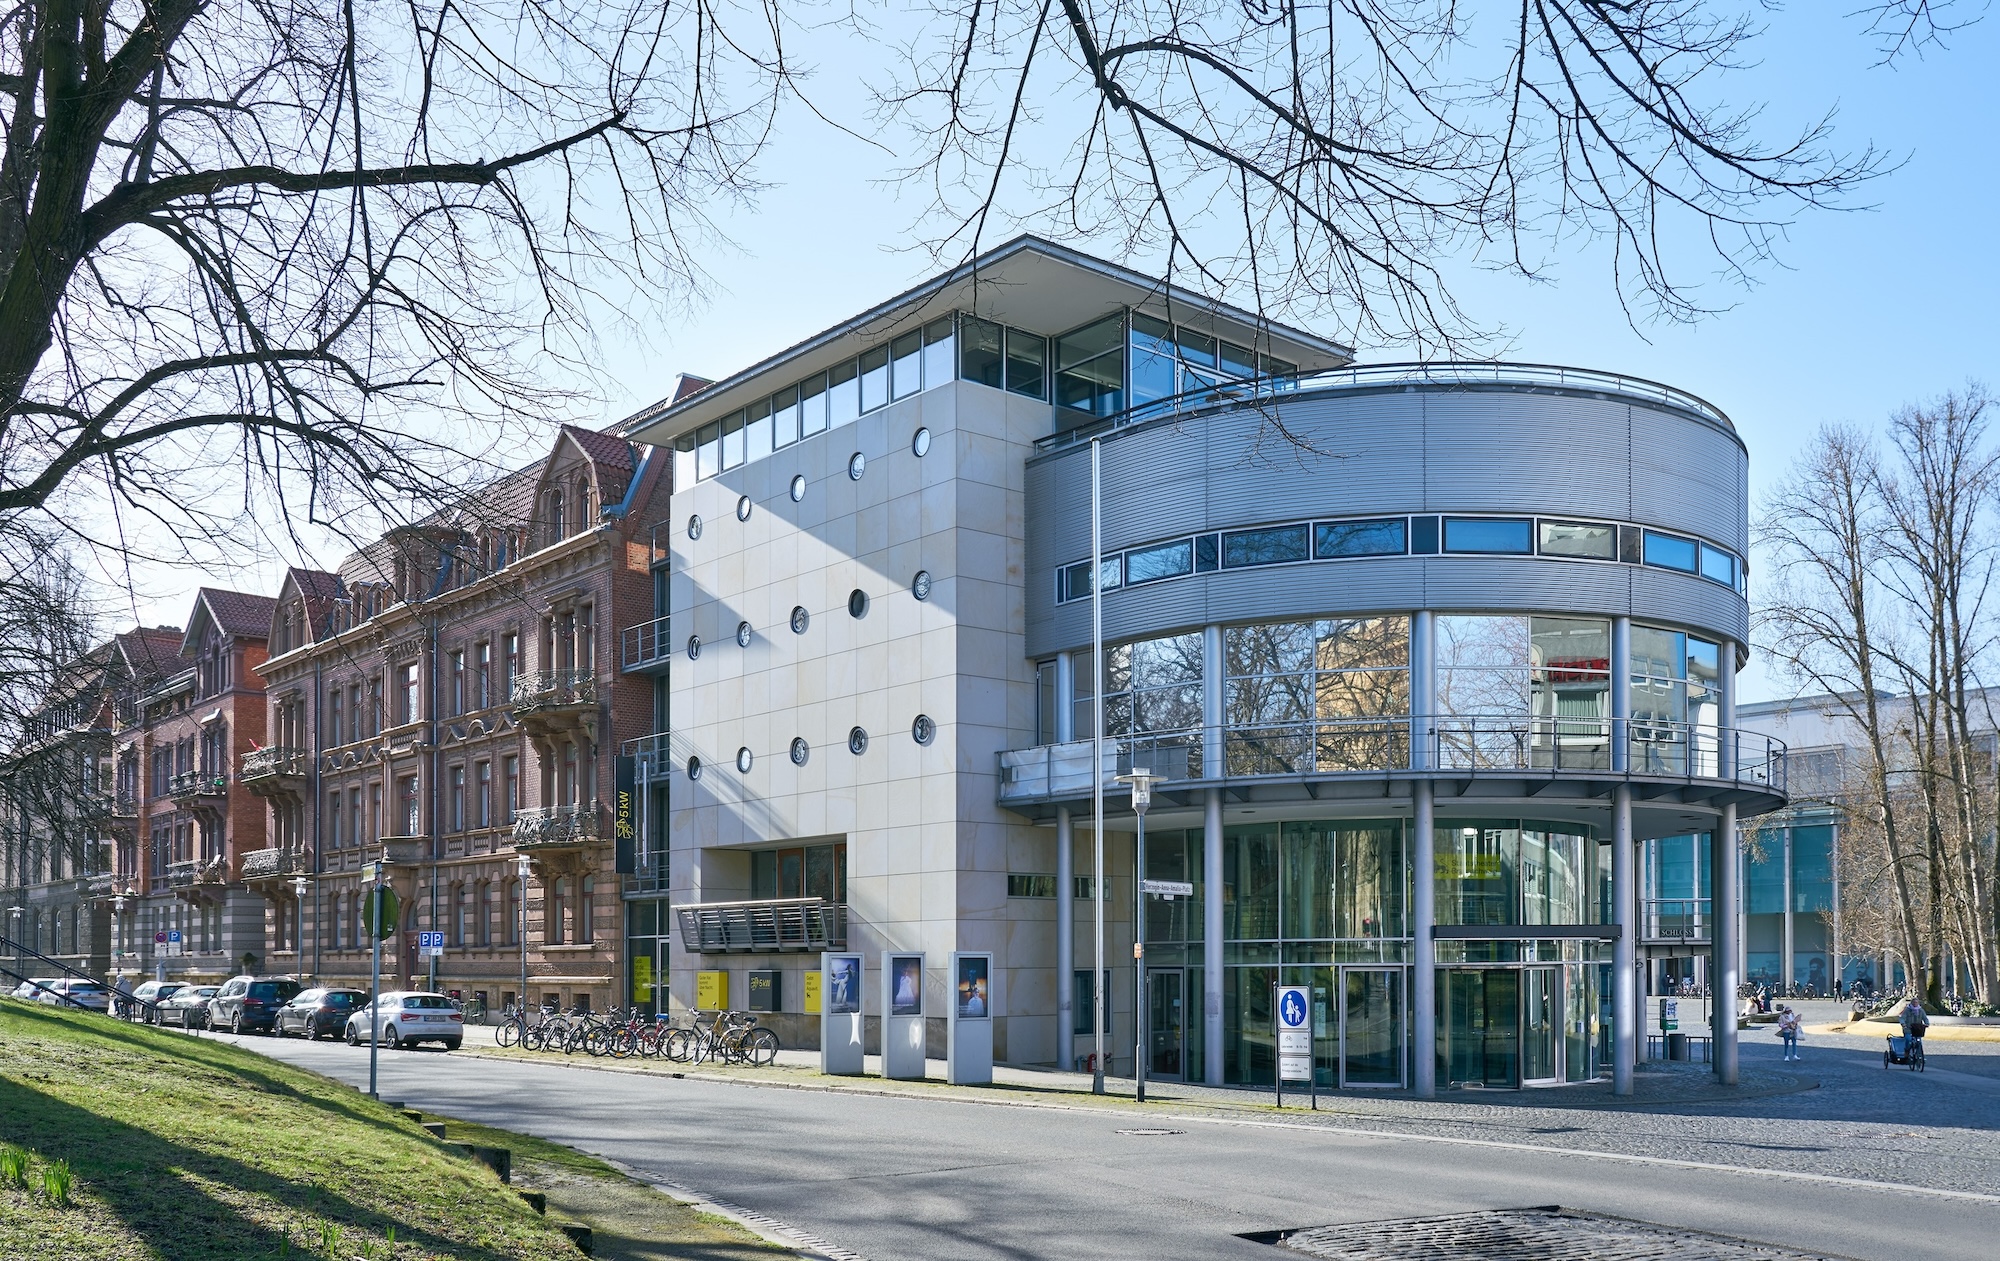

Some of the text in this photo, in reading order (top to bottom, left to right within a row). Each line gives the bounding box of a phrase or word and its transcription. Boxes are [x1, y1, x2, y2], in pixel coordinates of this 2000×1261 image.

[619, 791, 629, 818] 5 kW
[1452, 859, 1497, 867] Statsheater
[171, 932, 178, 941] P
[422, 934, 429, 945] P
[434, 934, 441, 945] P
